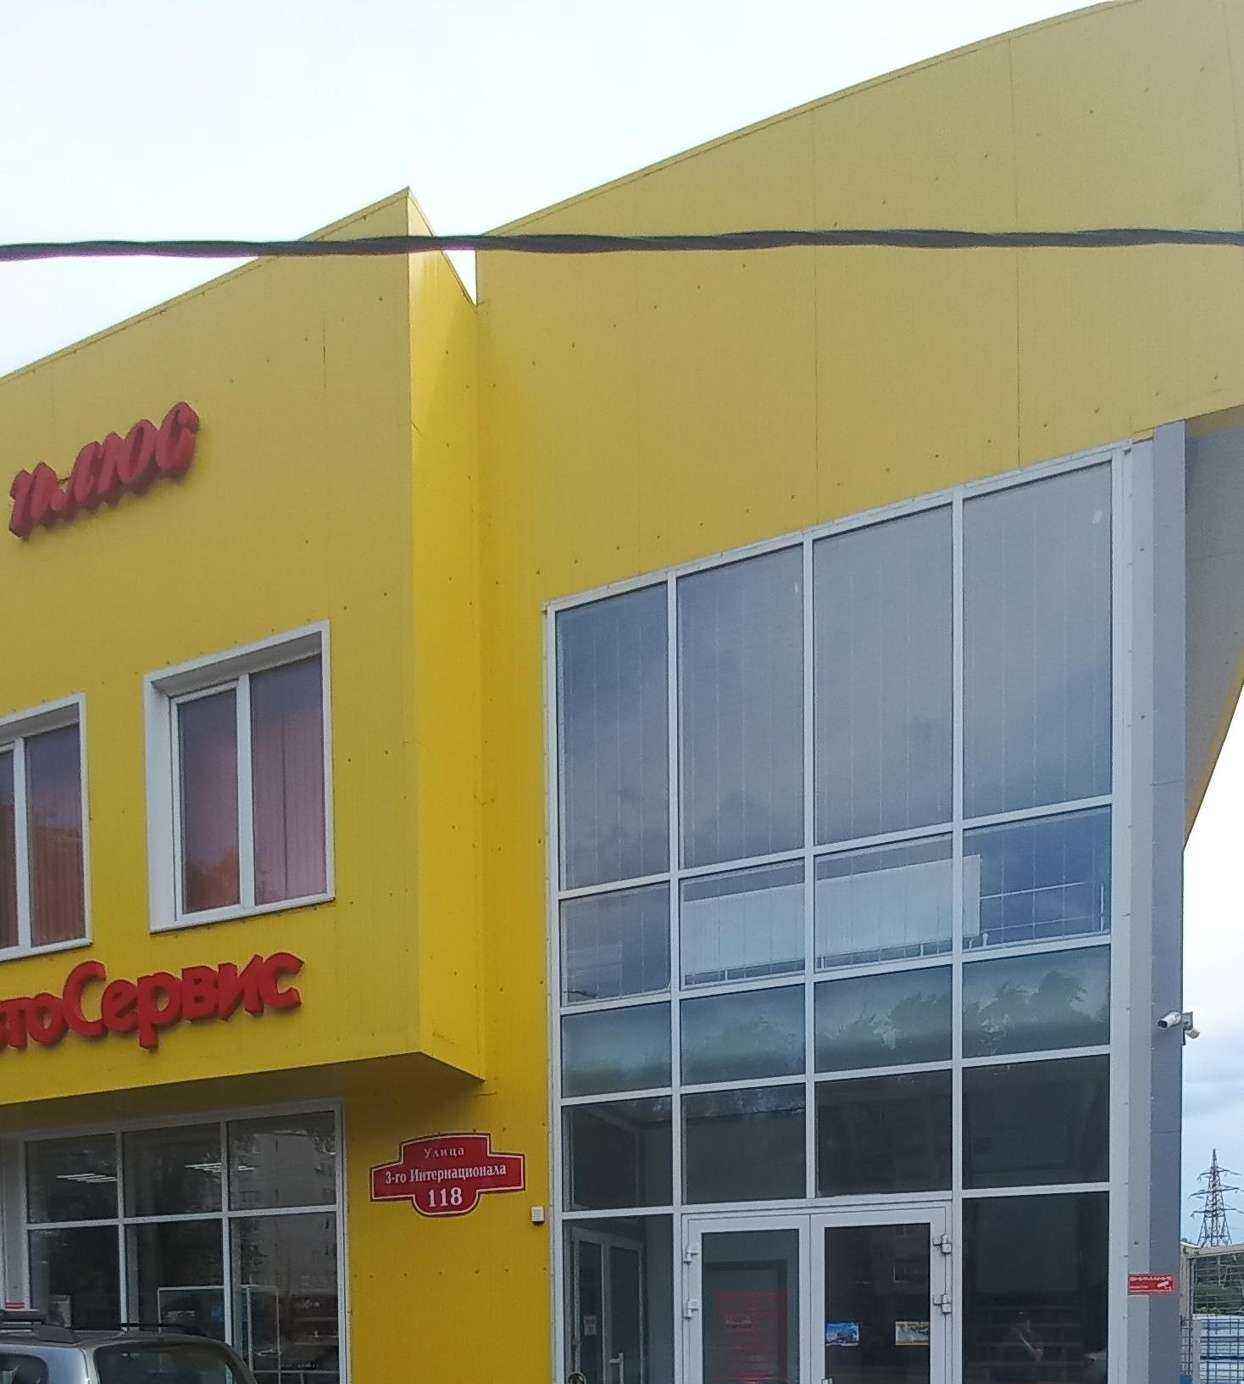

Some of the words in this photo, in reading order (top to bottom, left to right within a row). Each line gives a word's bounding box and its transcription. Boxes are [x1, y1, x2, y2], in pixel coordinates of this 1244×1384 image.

[0, 952, 304, 1050] тоСервис
[424, 1147, 465, 1160] Улица
[384, 1170, 407, 1184] 3-го
[410, 1164, 507, 1183] Интернационала
[428, 1187, 463, 1207] 118
